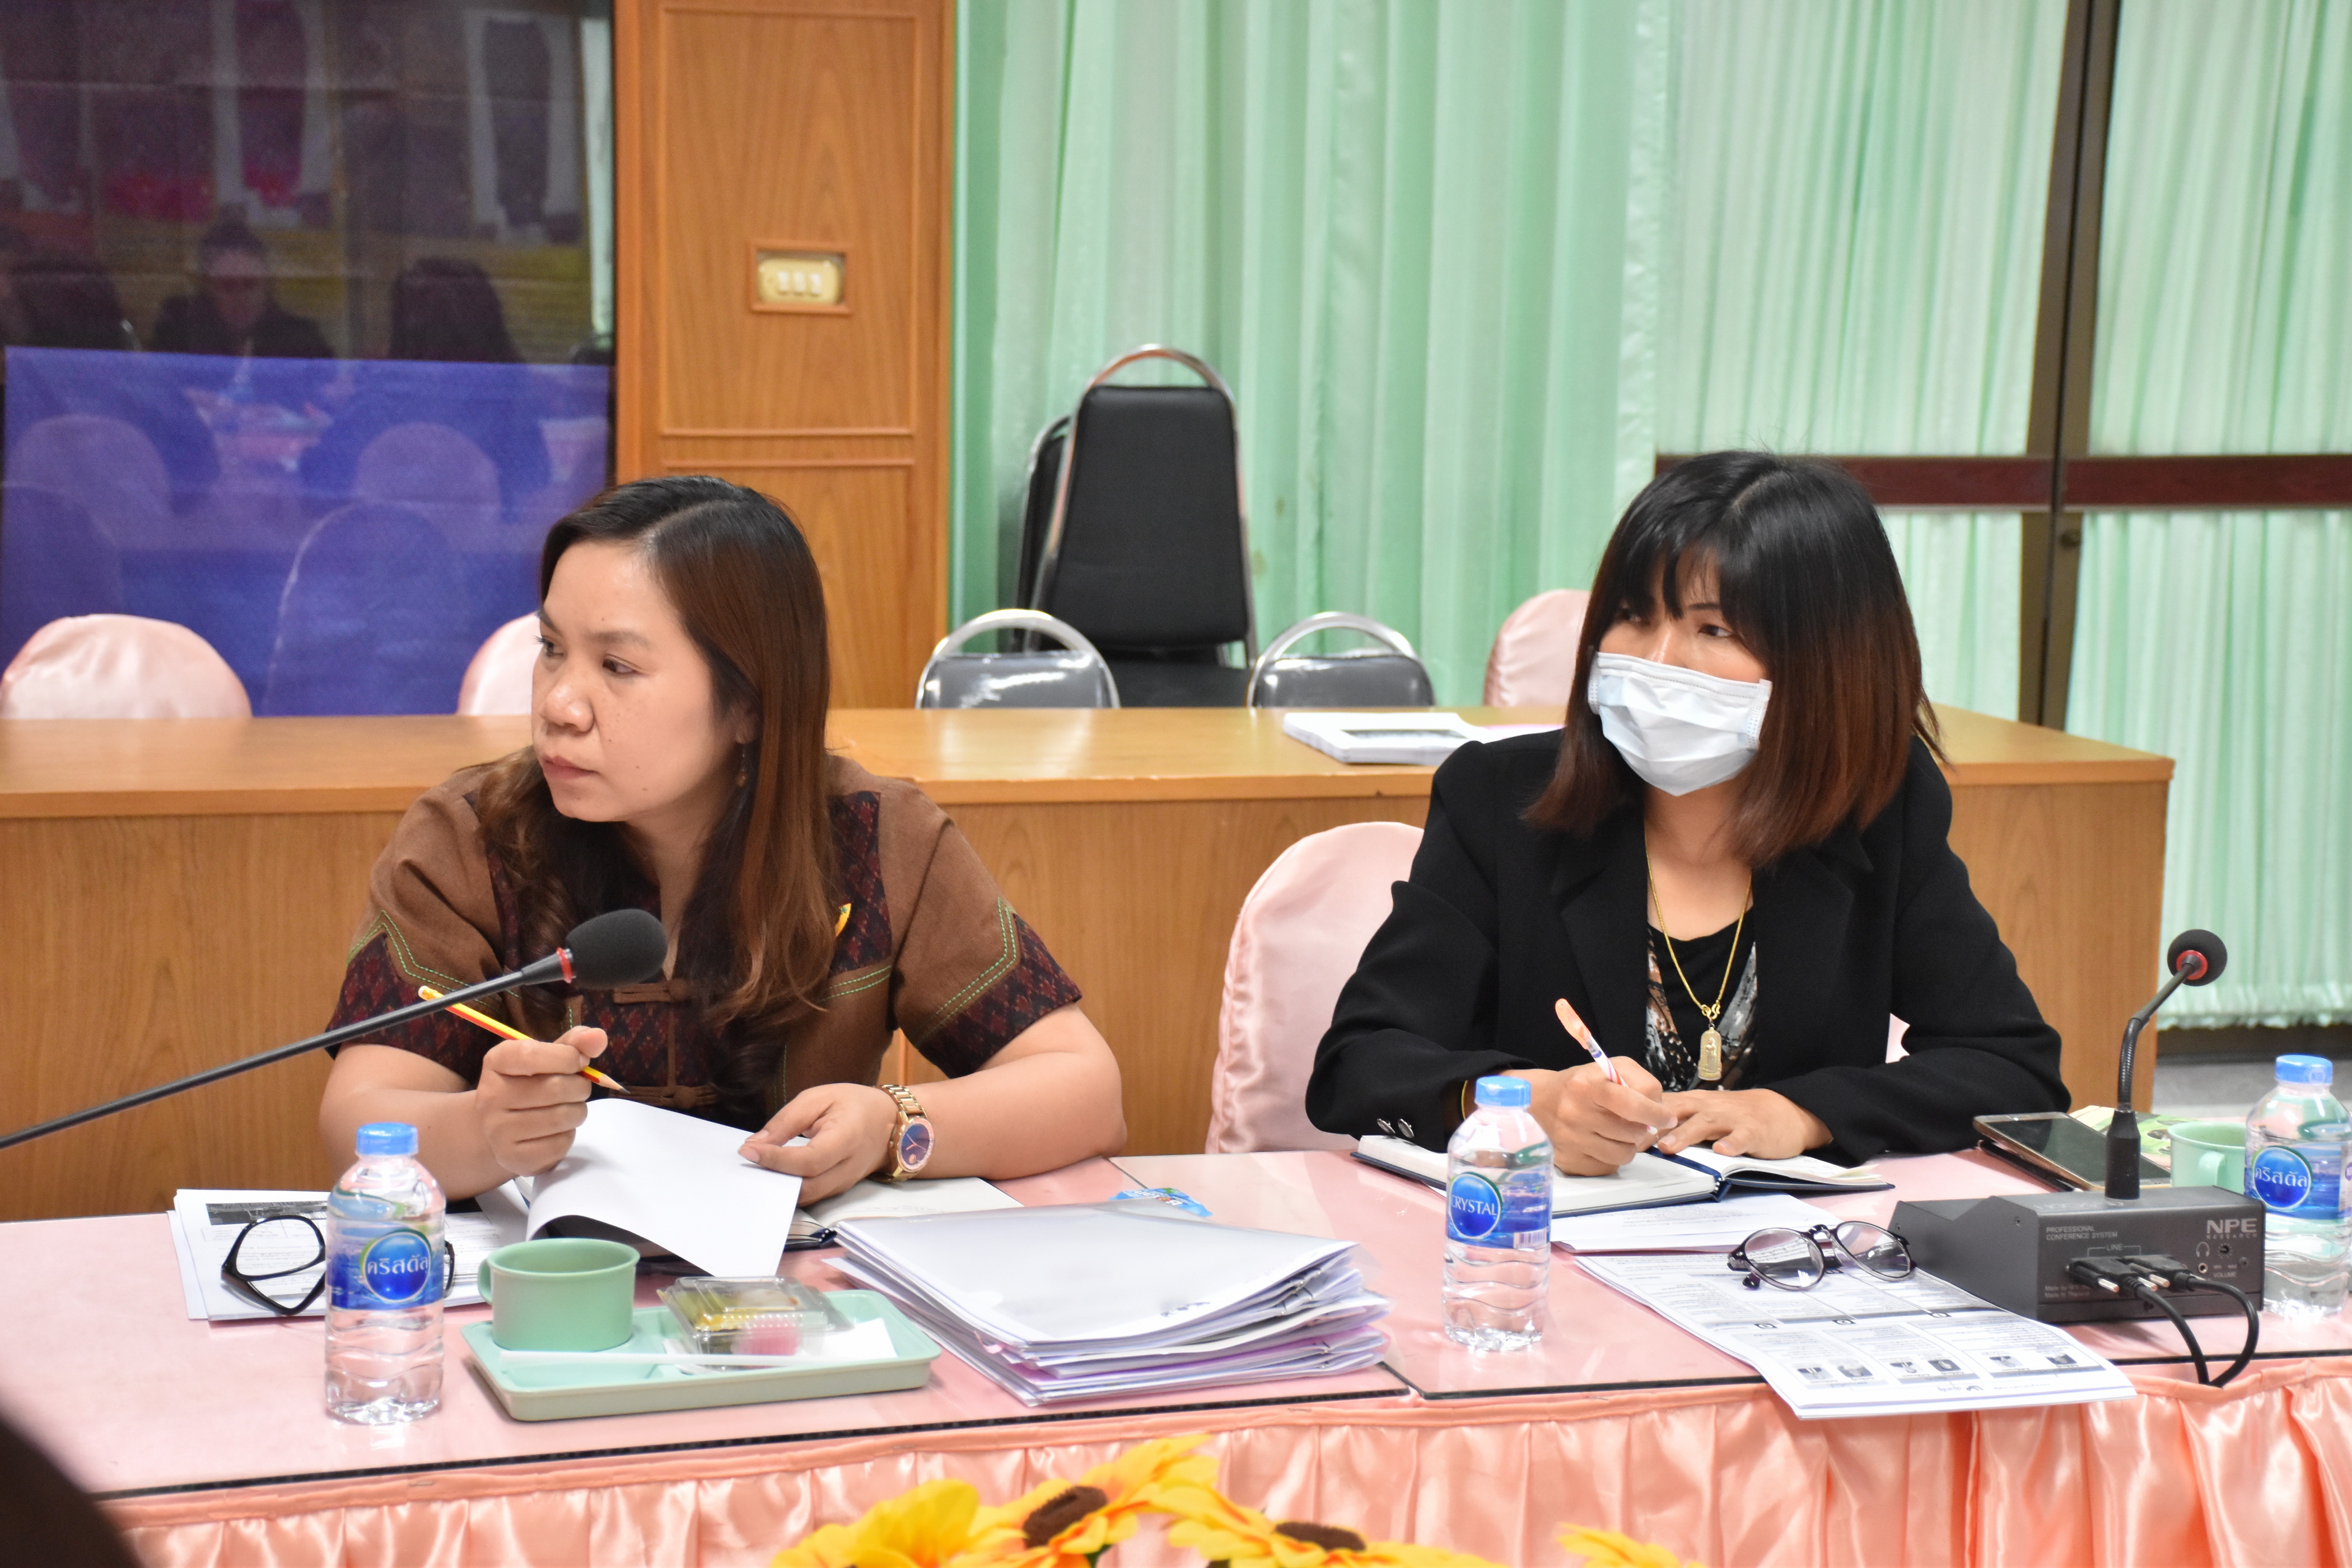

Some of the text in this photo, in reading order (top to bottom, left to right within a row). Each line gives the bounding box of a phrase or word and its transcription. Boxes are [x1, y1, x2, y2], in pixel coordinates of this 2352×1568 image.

[1452, 1194, 1497, 1216] CRYSTAL
[2206, 1218, 2257, 1234] NPE
[367, 1253, 428, 1275] คริสตัล
